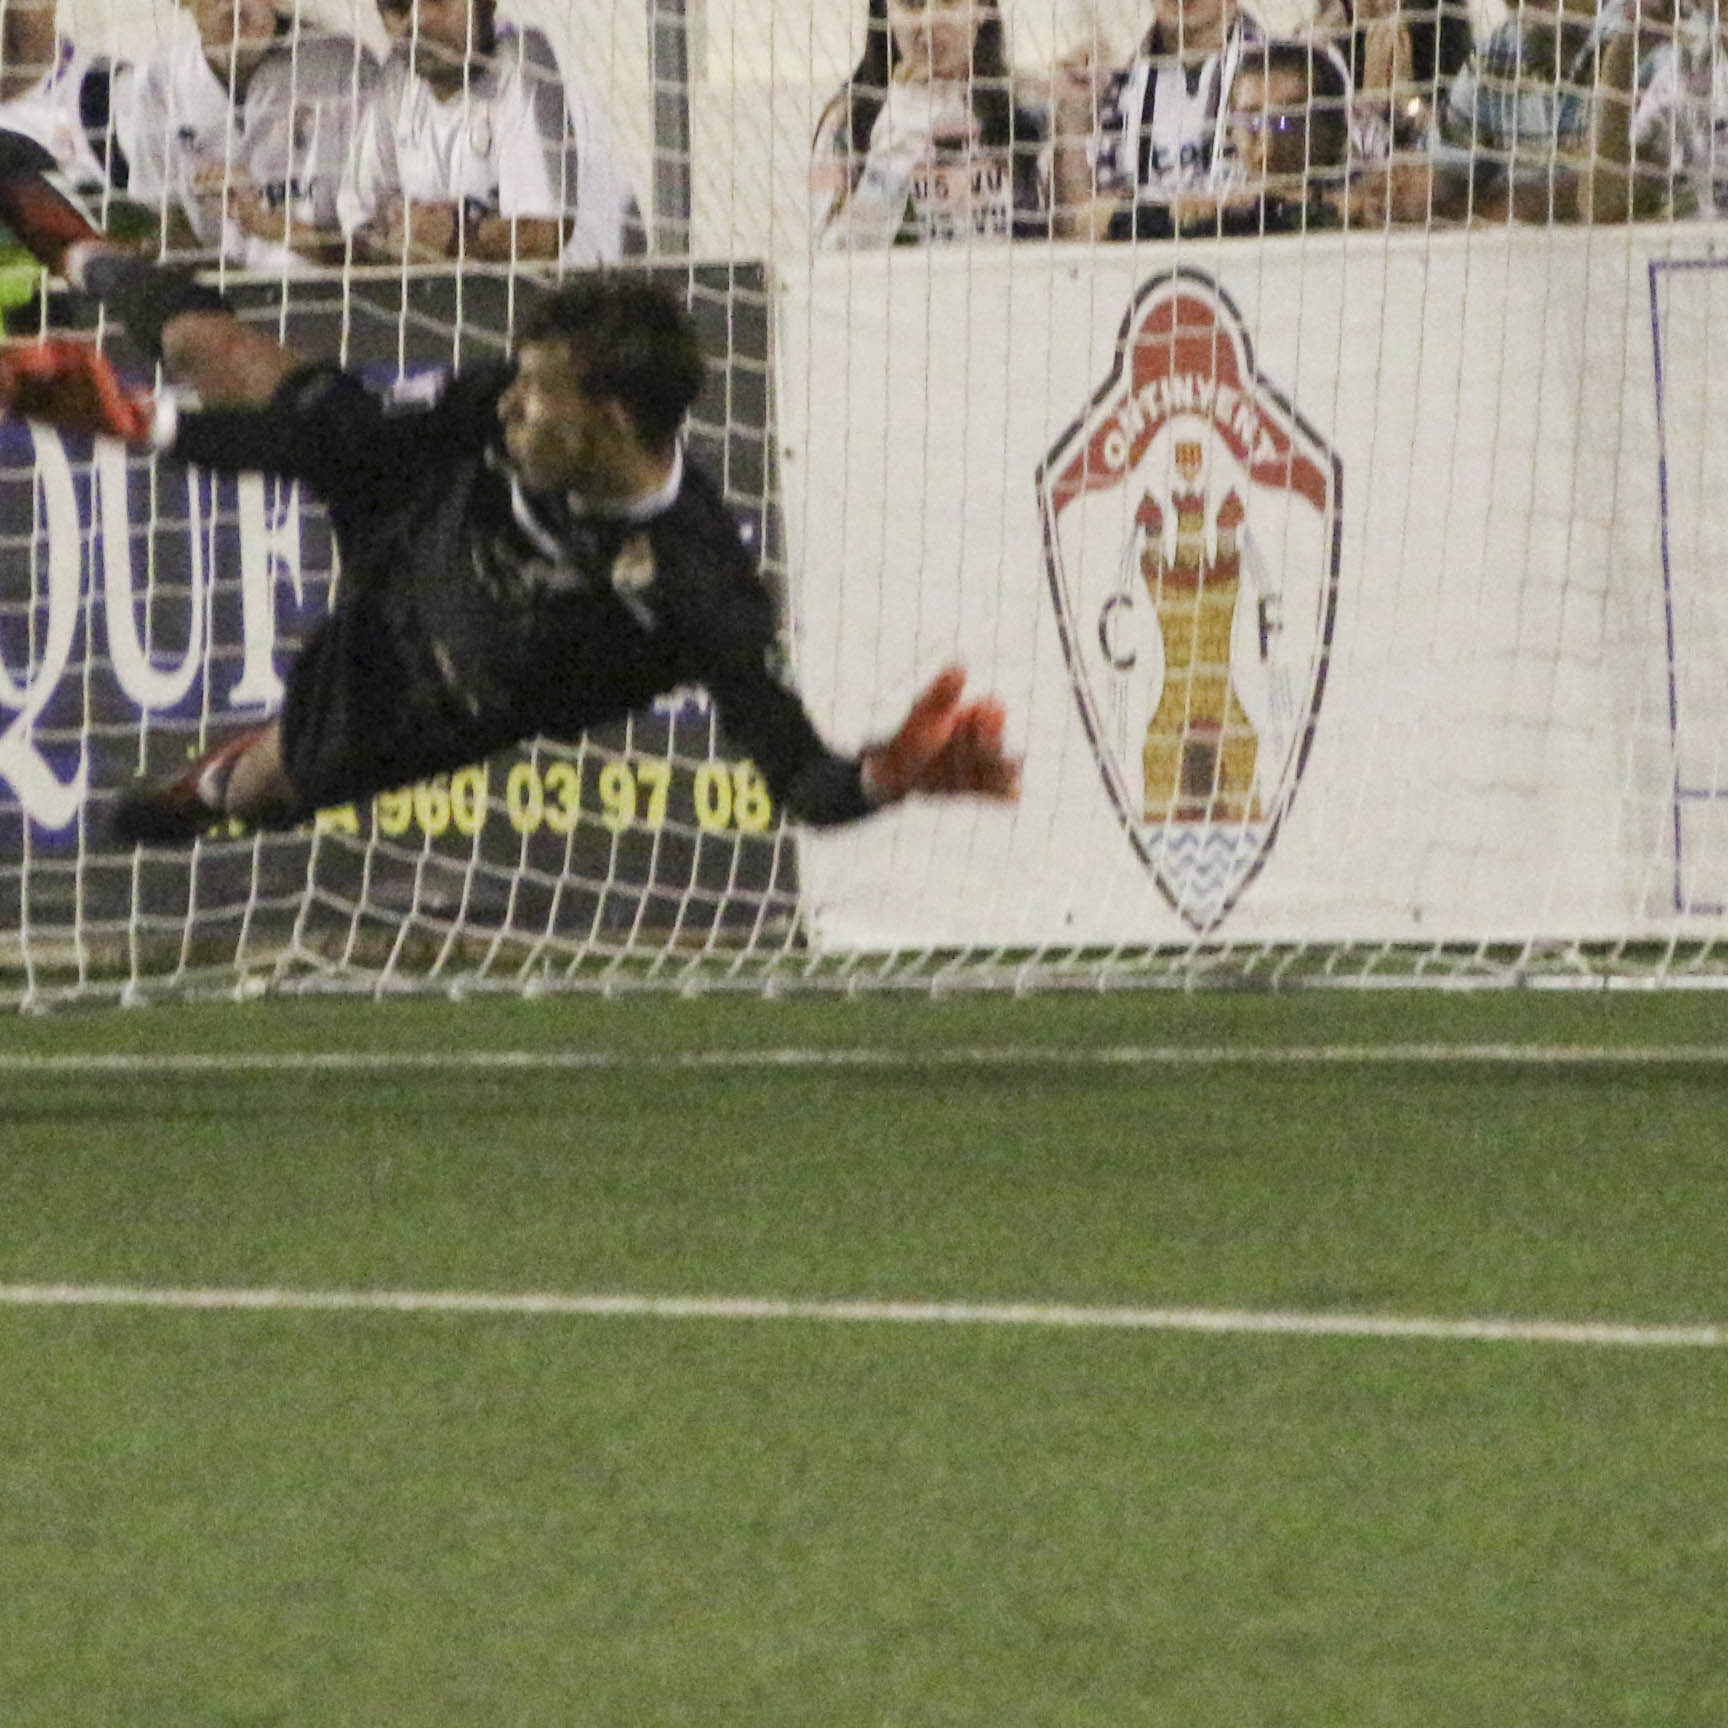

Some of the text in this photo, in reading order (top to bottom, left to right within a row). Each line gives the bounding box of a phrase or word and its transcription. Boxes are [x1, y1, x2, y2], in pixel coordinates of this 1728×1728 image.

[1097, 593, 1284, 671] C F
[506, 760, 582, 835] 03
[598, 759, 672, 832] 97
